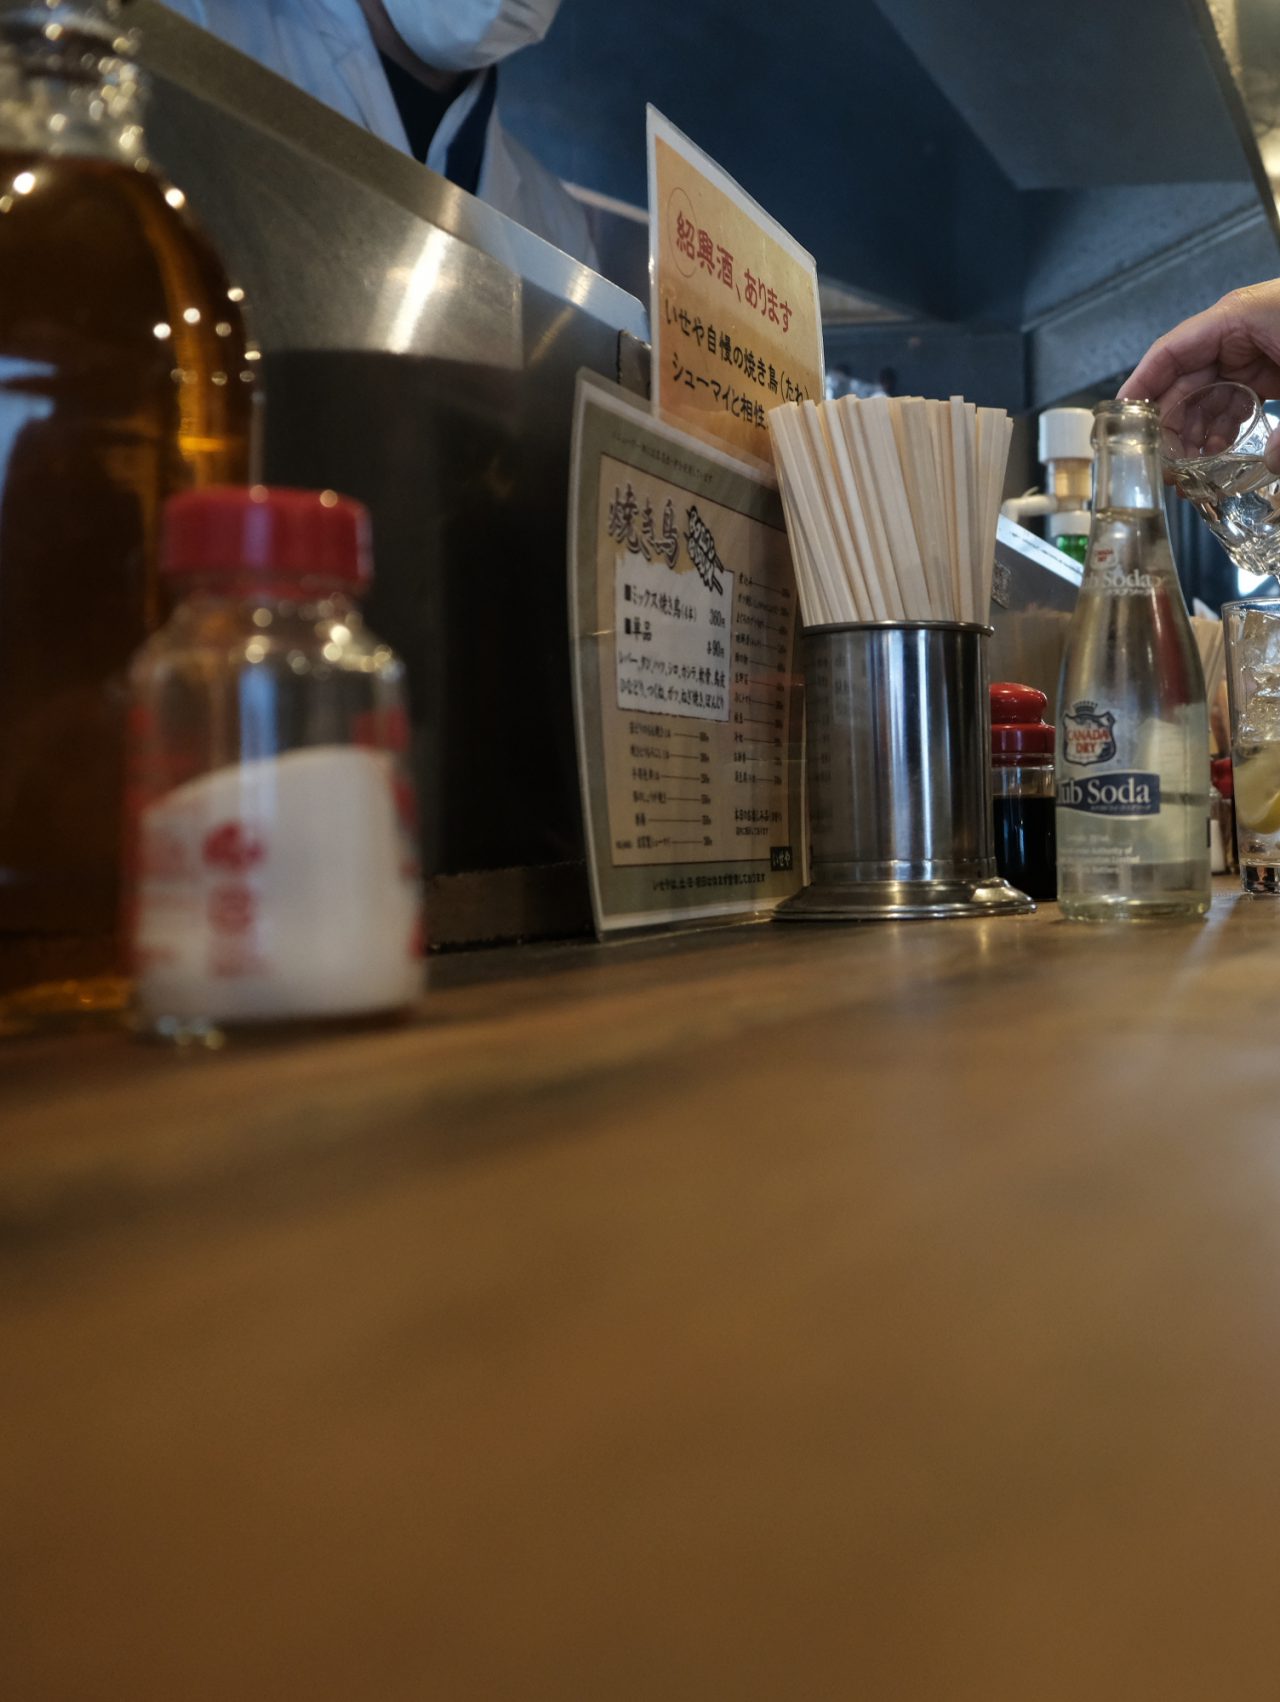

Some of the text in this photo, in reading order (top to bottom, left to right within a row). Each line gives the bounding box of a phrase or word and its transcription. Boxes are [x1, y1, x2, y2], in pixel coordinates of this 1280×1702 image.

[676, 210, 793, 333] 紹興酒、あります
[672, 352, 769, 430] シューマイと相性
[608, 483, 679, 570] 焼き鳥
[1103, 568, 1152, 588] Soda
[632, 616, 652, 642] 単品
[1067, 728, 1110, 741] CANADA
[1076, 743, 1096, 753] DRY
[1087, 777, 1151, 804] Soda
